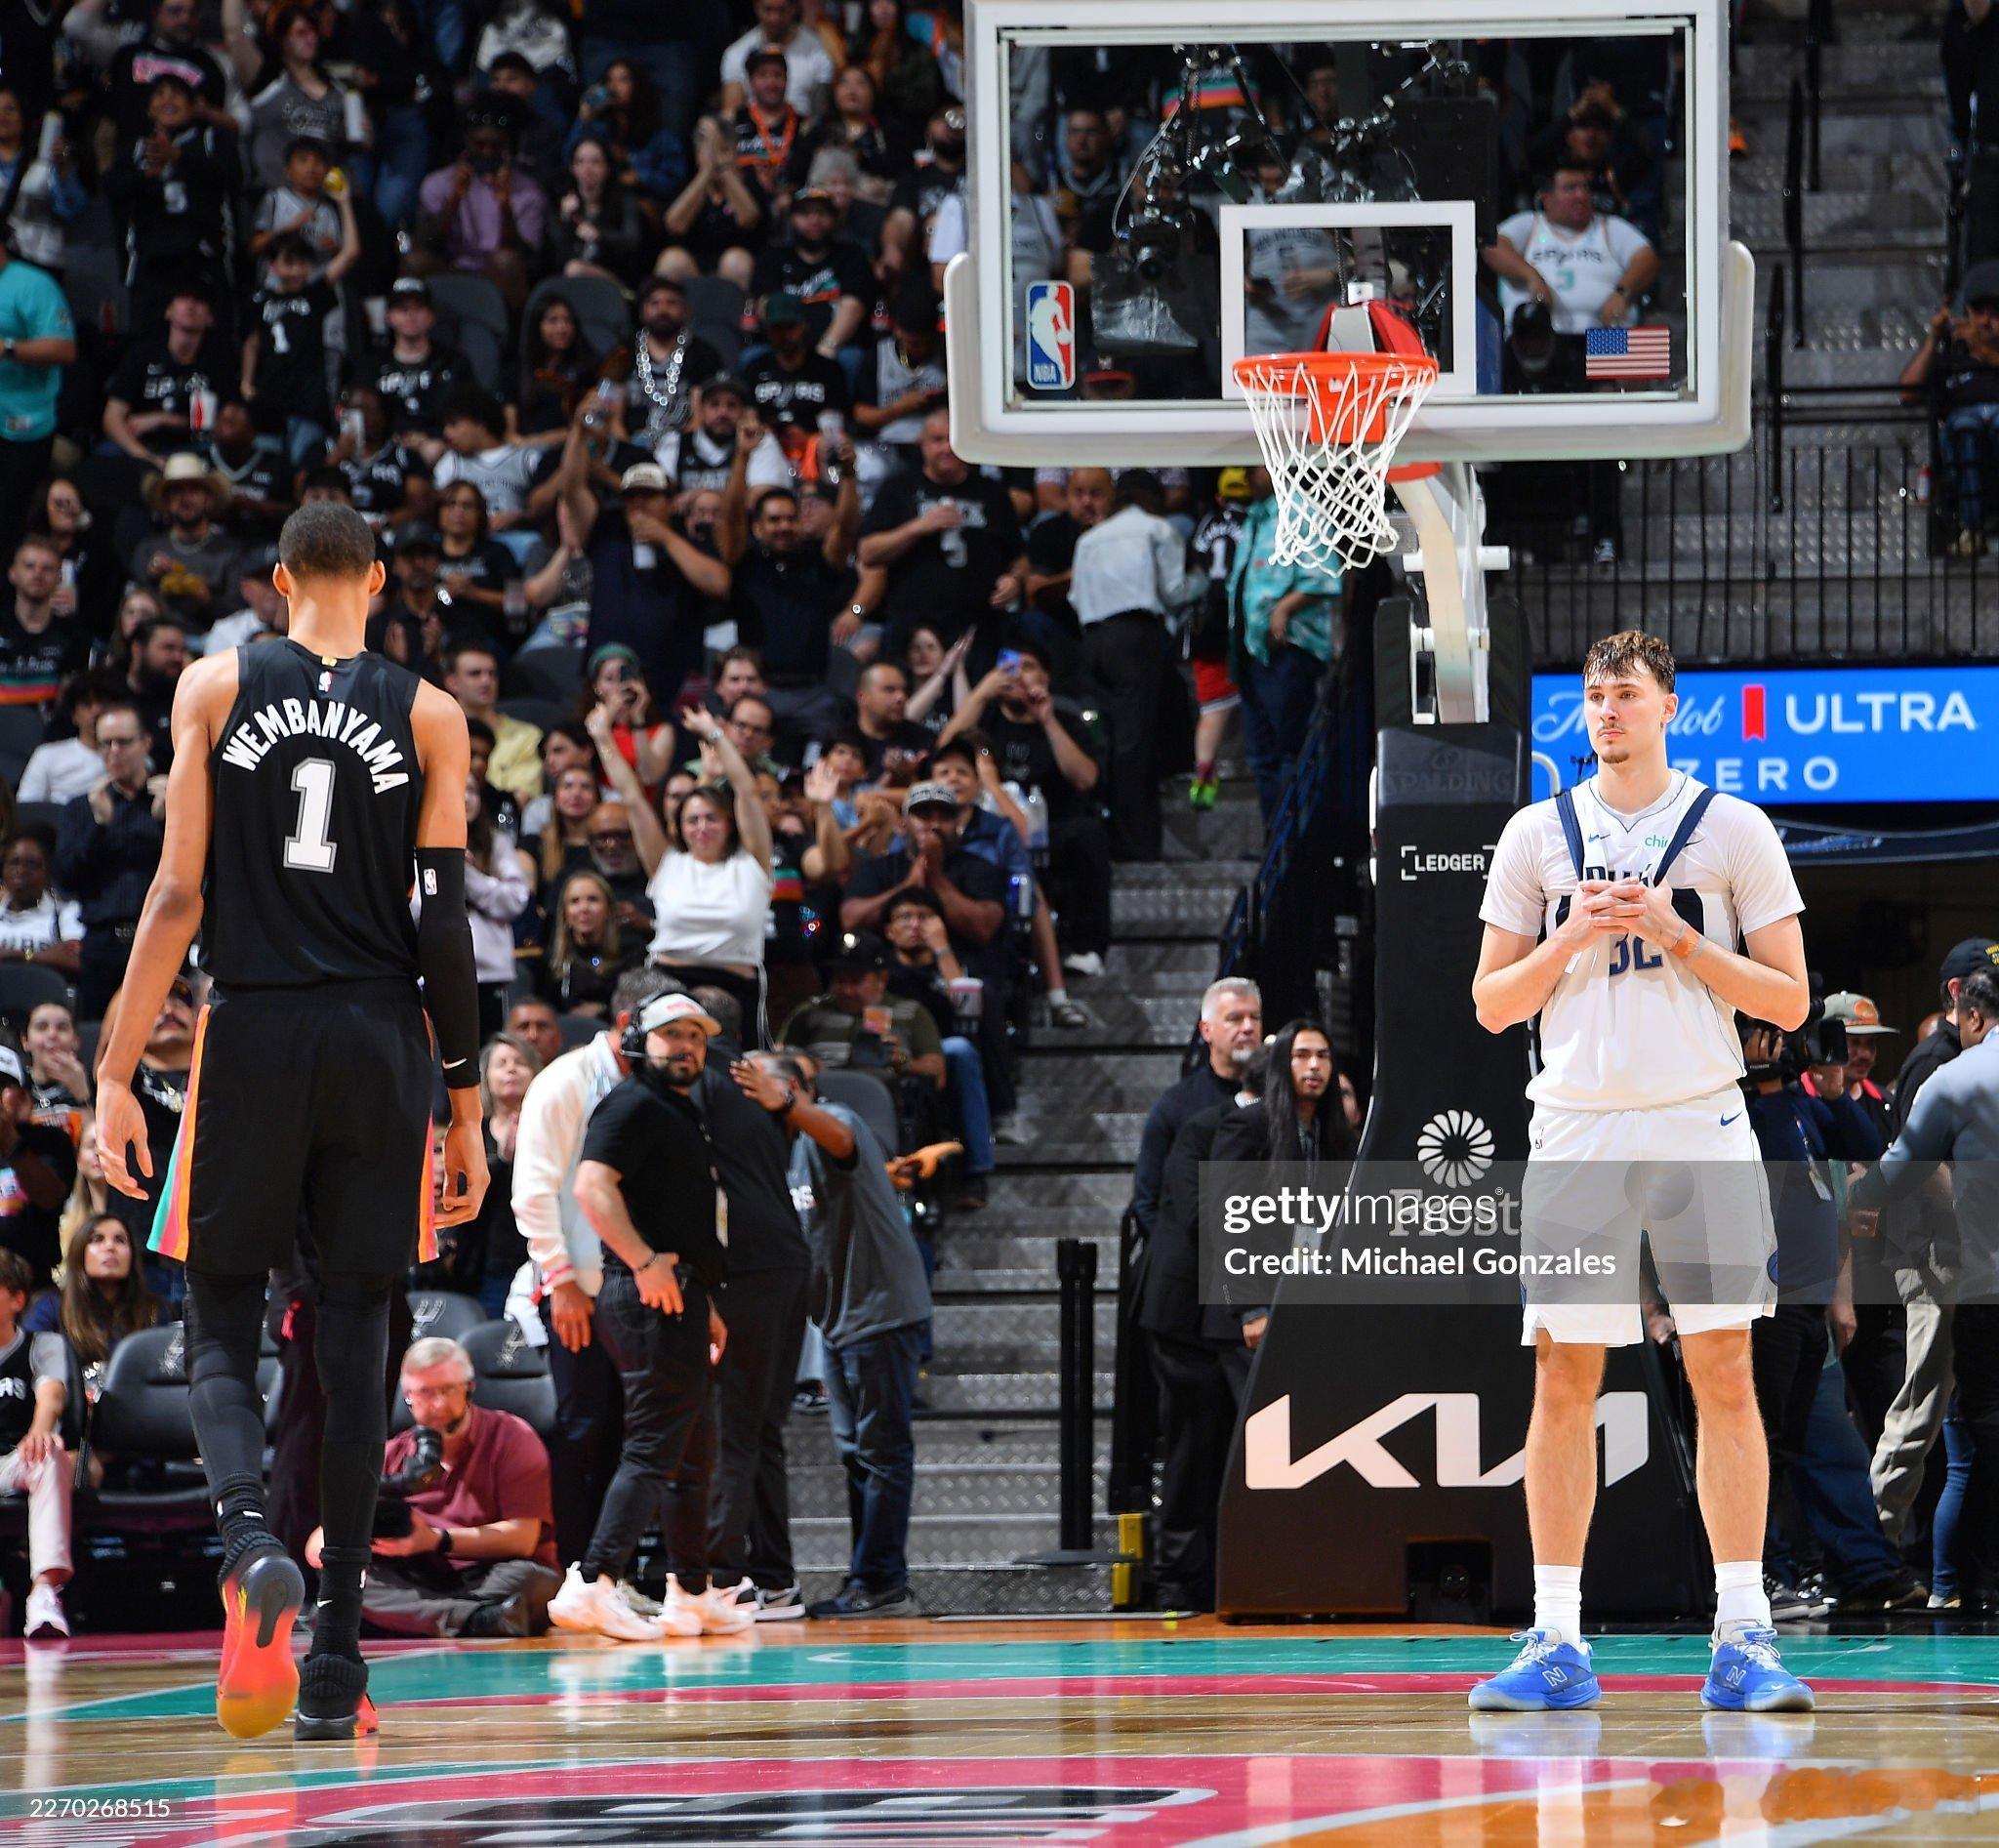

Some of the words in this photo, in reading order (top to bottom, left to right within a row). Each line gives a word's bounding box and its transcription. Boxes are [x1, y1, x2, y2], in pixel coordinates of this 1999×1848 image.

[1034, 363, 1057, 383] NBA
[1209, 537, 1228, 579] 1
[1785, 690, 1978, 733] ULTRA
[223, 697, 410, 795] WEMBANYAMA
[283, 757, 338, 874] 1
[1413, 853, 1486, 872] LEDGER
